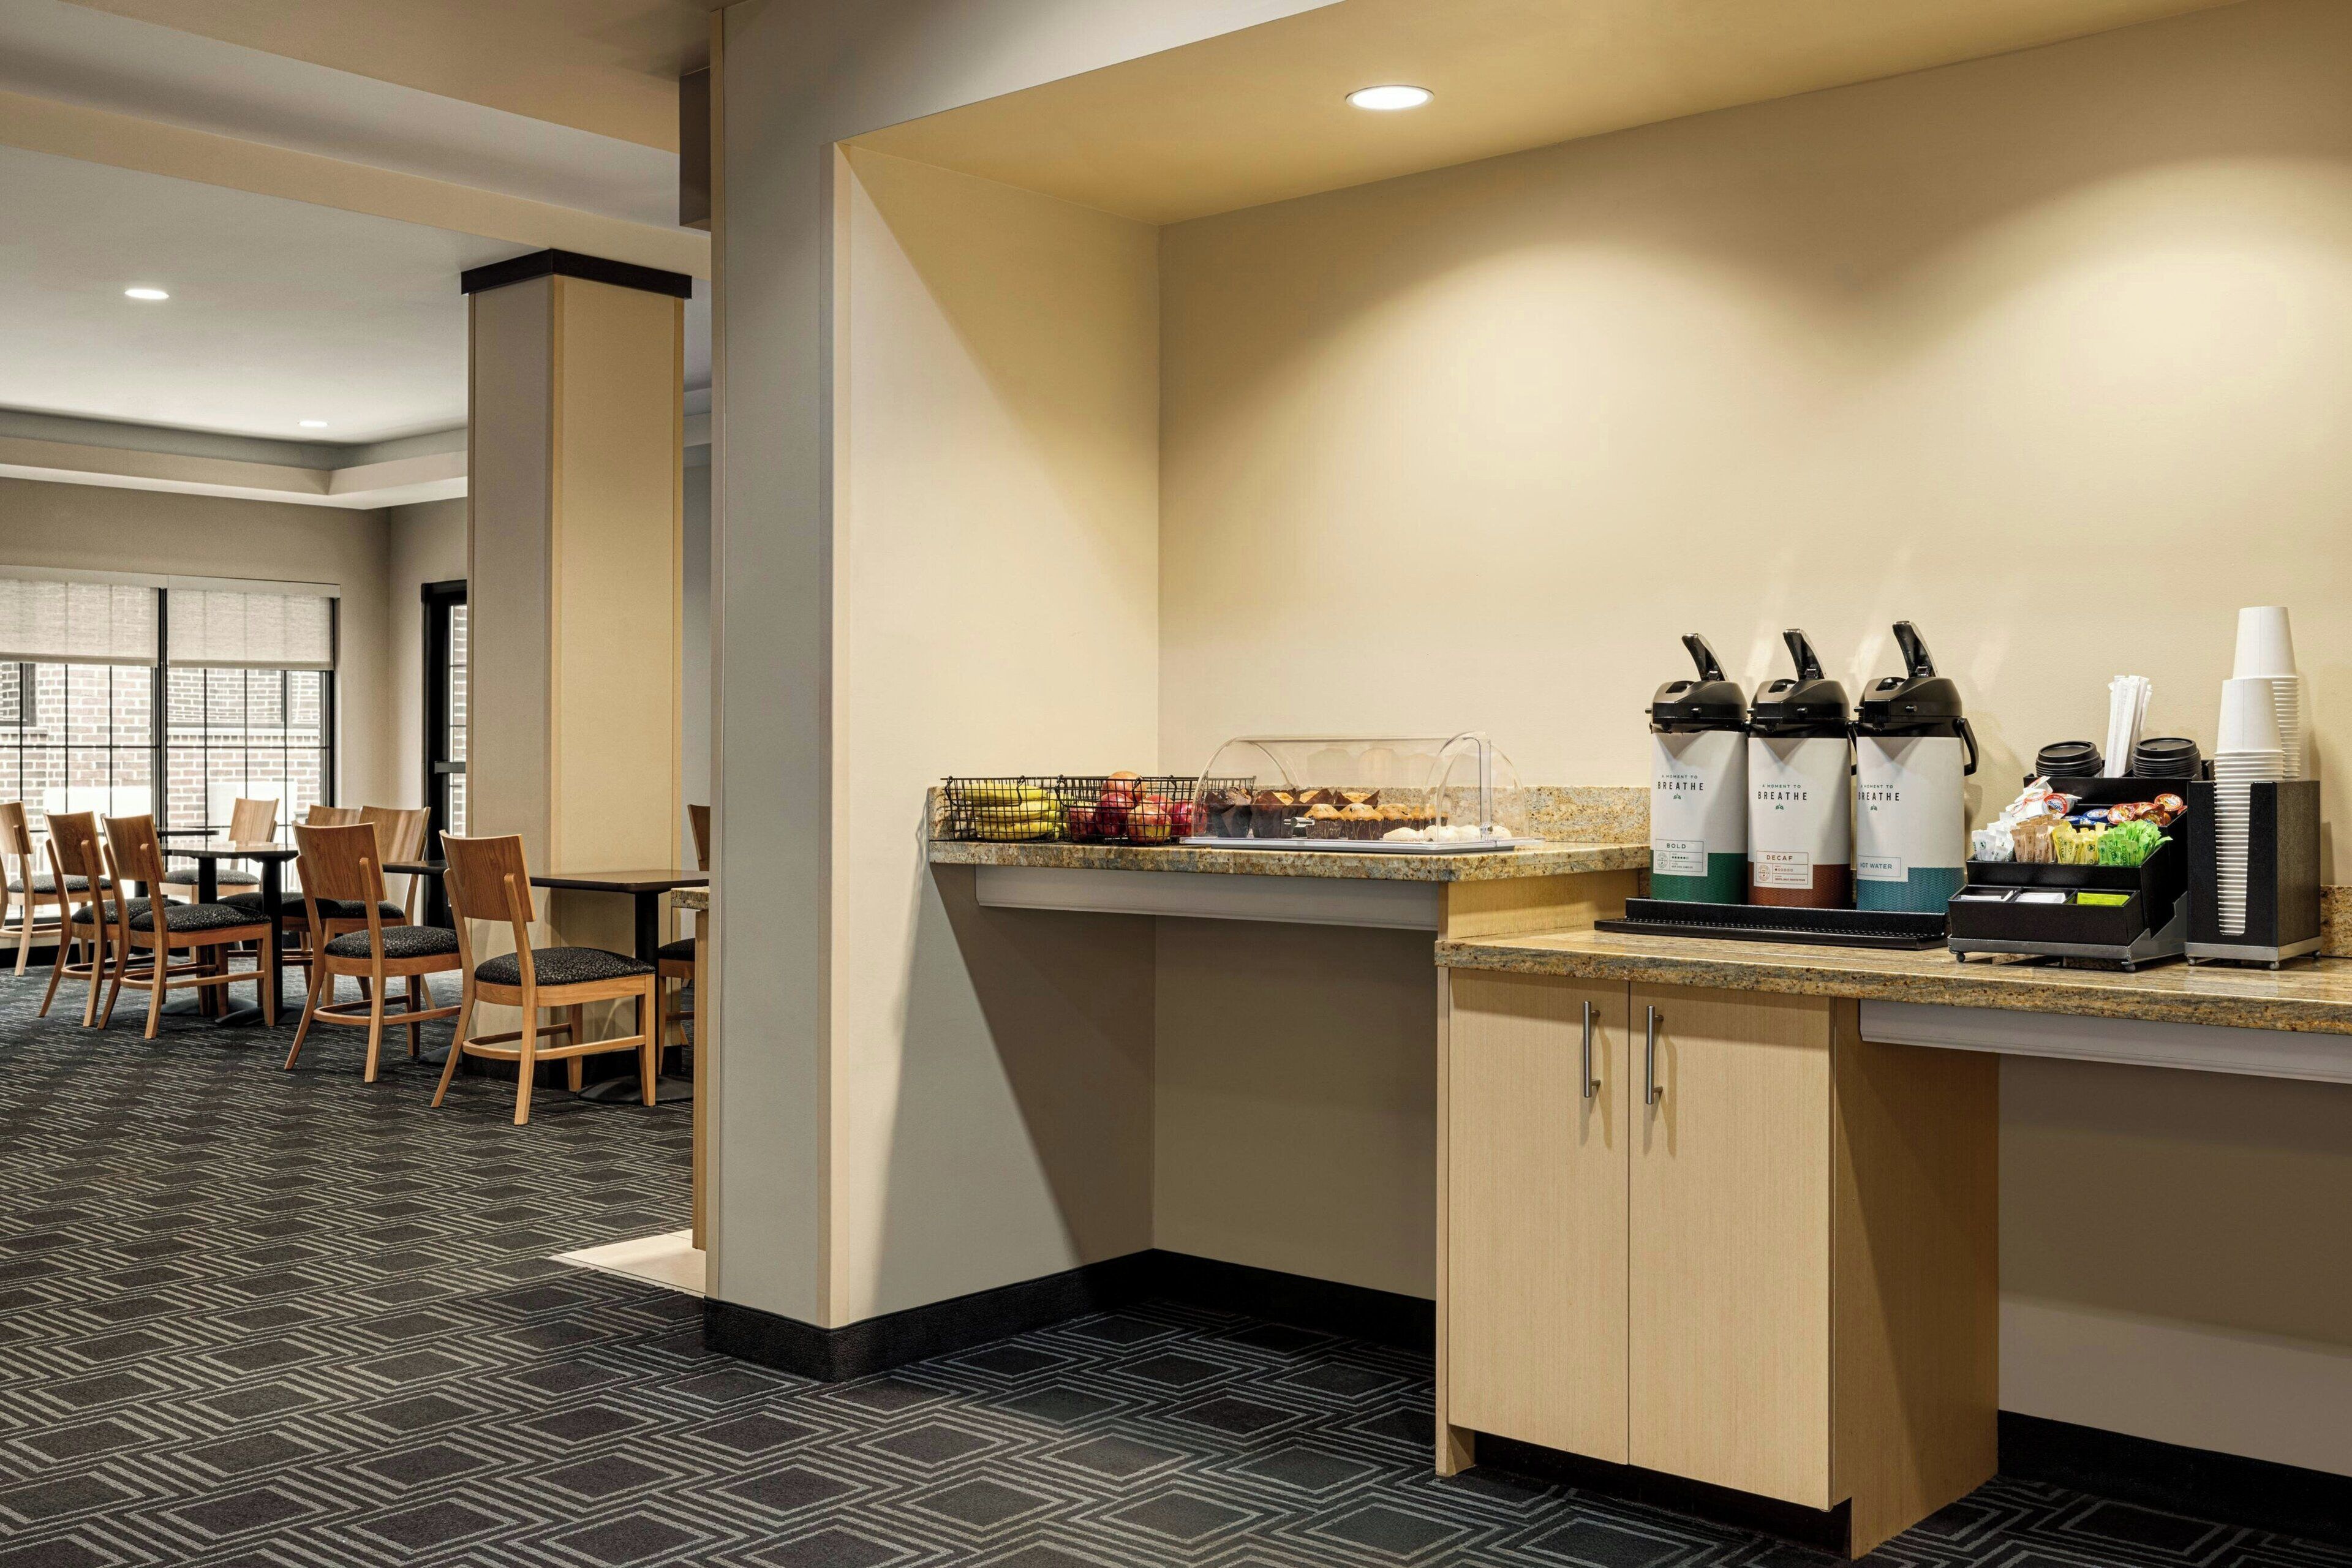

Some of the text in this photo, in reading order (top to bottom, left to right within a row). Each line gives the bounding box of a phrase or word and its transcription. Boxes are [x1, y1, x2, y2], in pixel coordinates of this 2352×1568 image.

[1657, 782, 1703, 791] BREATHE
[1758, 791, 1807, 801] BREATHE
[1858, 792, 1899, 801] BREATHE
[2048, 800, 2063, 811] delight
